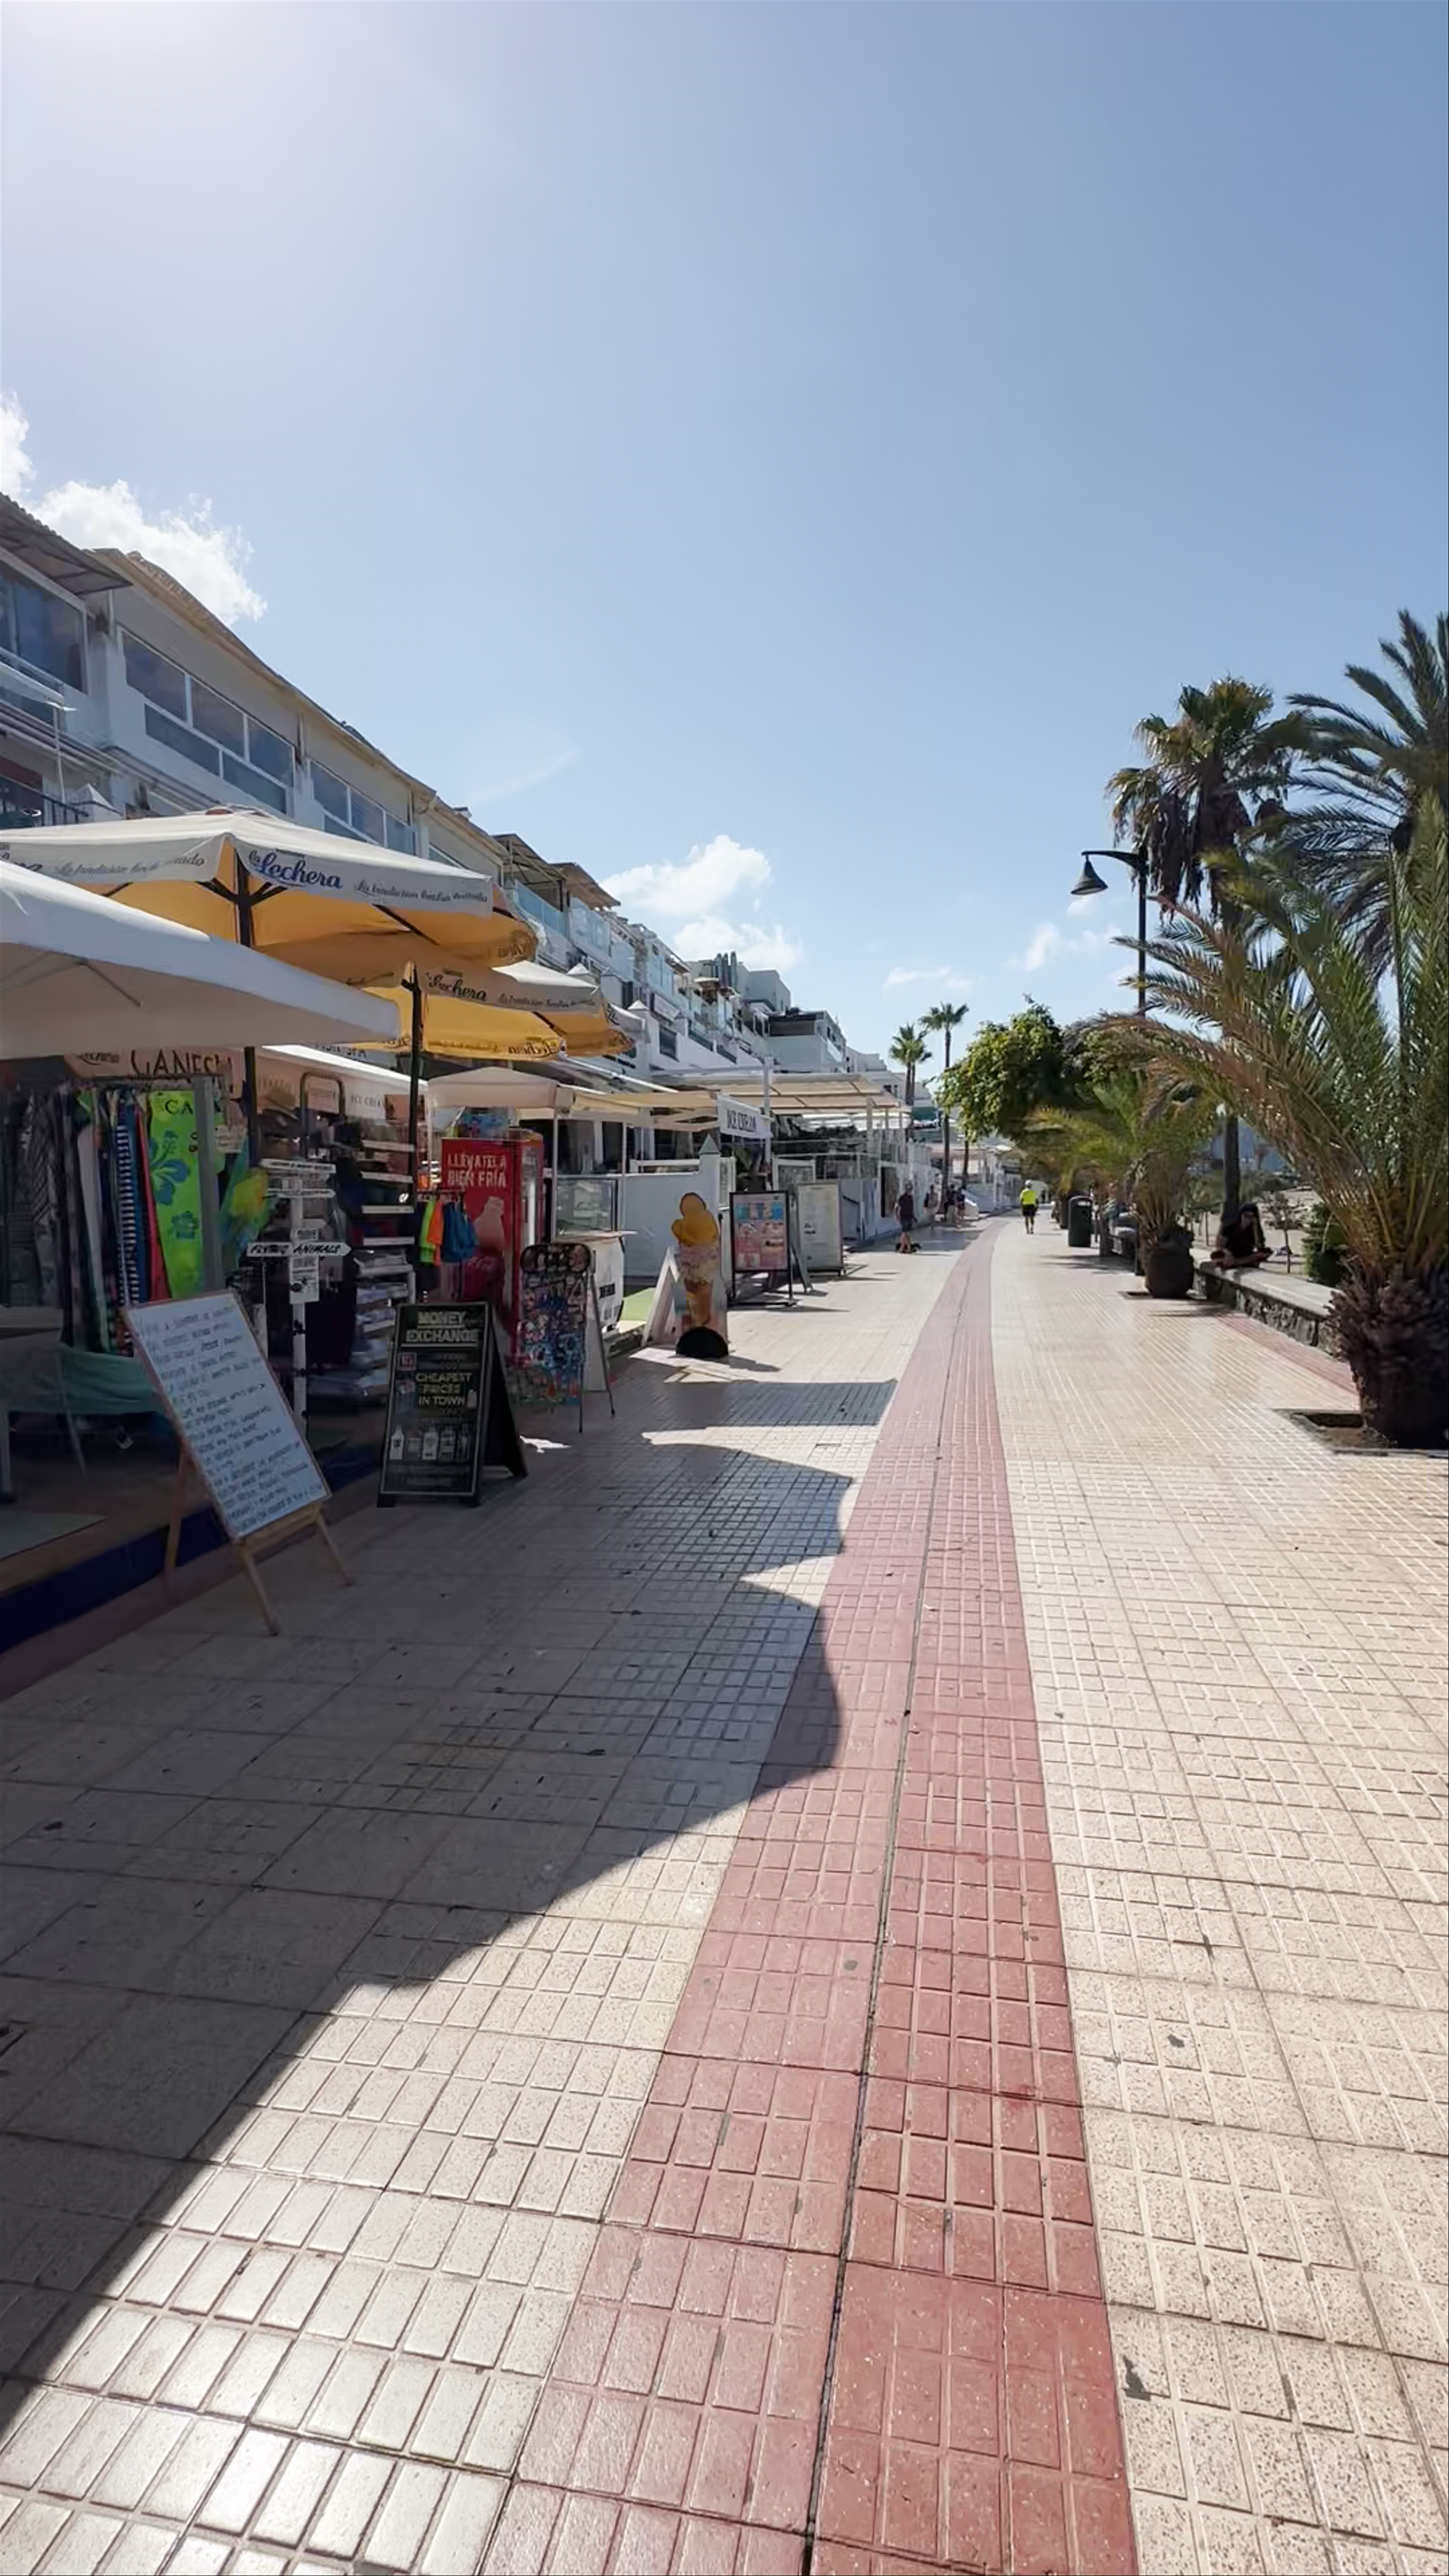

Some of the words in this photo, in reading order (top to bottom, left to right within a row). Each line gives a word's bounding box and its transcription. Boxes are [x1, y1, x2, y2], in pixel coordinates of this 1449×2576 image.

[261, 852, 343, 889] Lechera
[429, 974, 487, 1001] Lechera
[293, 1244, 341, 1255] ANIMALS
[418, 1311, 465, 1325] MONEY
[406, 1329, 478, 1342] EXCHANGE
[416, 1373, 472, 1383] CHEAPEST
[423, 1384, 461, 1394] PRICES
[419, 1396, 431, 1406] IN
[434, 1396, 465, 1406] TOWN
